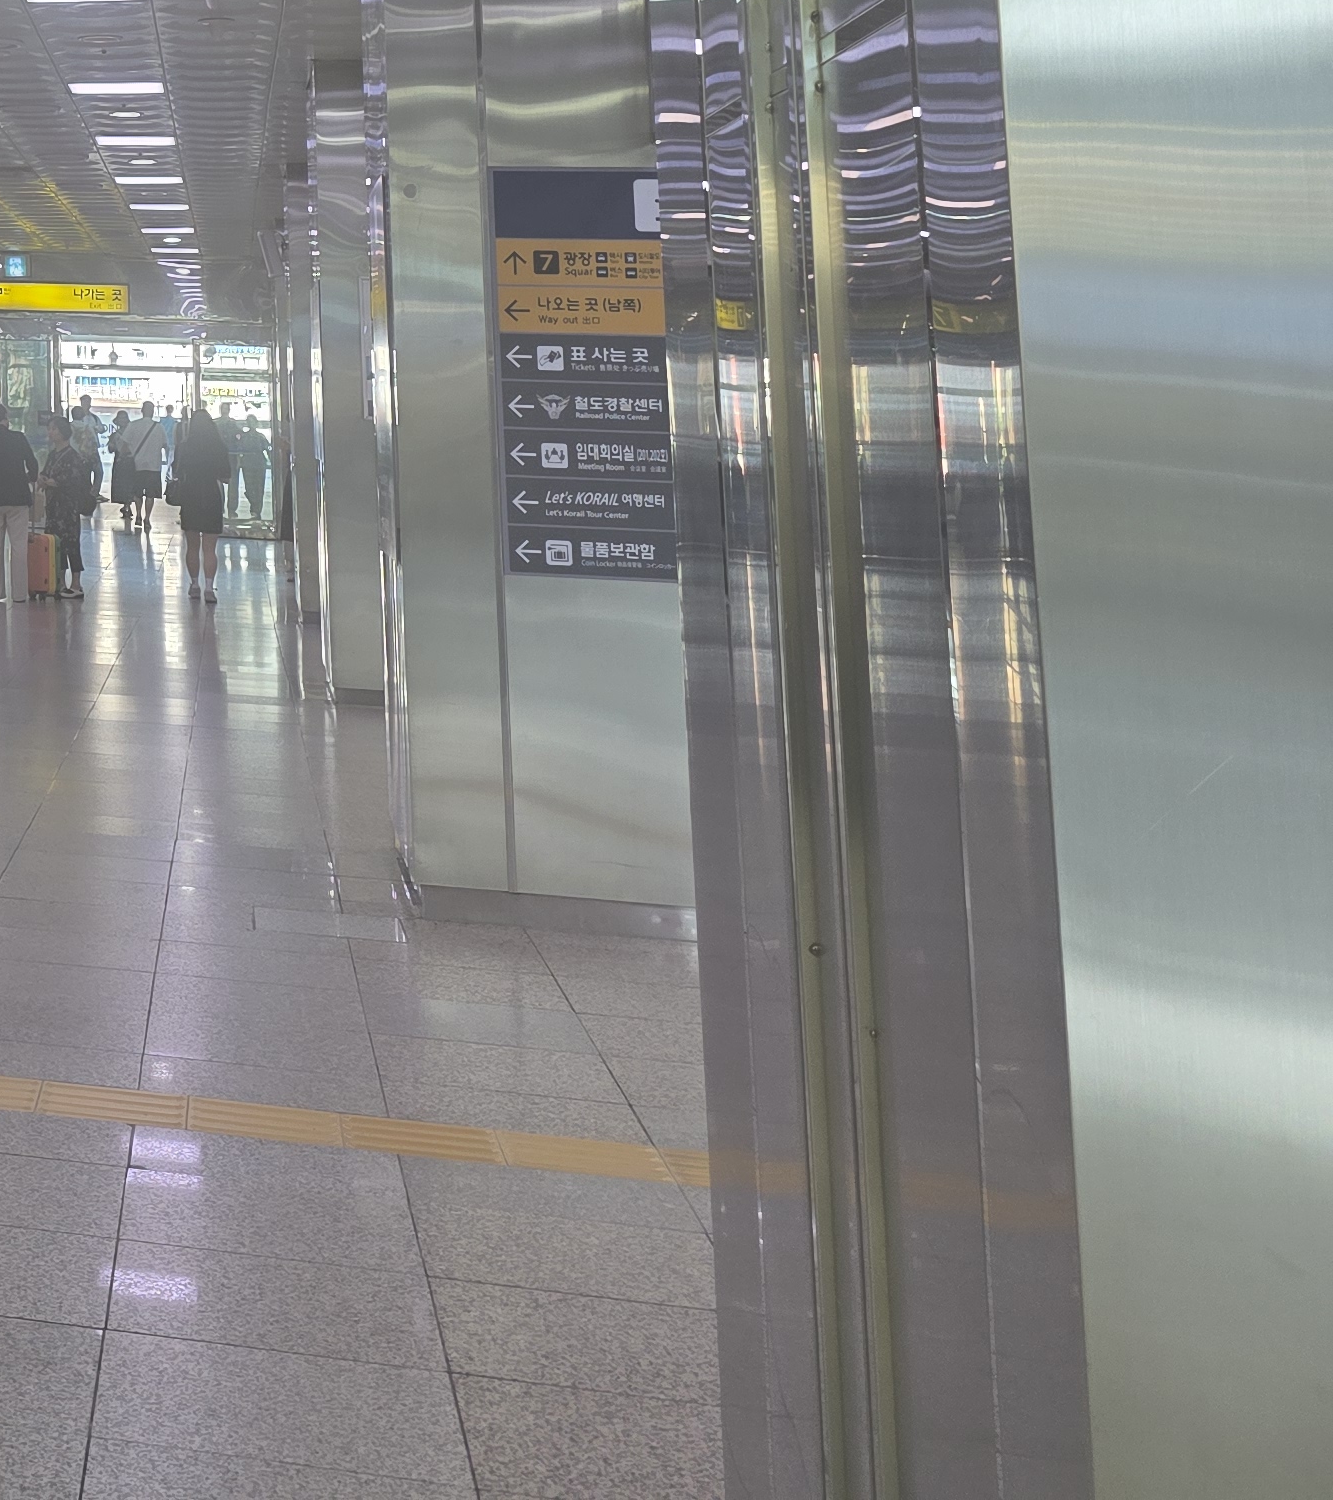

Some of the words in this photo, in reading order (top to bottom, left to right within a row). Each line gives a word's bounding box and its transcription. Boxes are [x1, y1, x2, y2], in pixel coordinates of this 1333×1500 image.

[539, 254, 554, 271] 7
[563, 252, 593, 267] 광장
[73, 288, 106, 301] 나가는
[111, 289, 122, 301] 곳
[537, 296, 580, 312] 나오는
[585, 297, 599, 312] 곳
[602, 297, 642, 313] (남쪽)
[538, 315, 559, 326] Way
[562, 316, 579, 325] out
[582, 316, 600, 325] 出口
[570, 346, 587, 361] 표
[591, 347, 627, 362] 사는
[631, 348, 649, 363] 곳
[570, 363, 596, 371] Tickets
[574, 395, 663, 413] 철도경찰센터
[575, 412, 604, 420] Railroad
[604, 412, 626, 421] Police
[626, 413, 651, 421] Center
[575, 442, 635, 462] 임대회의실
[577, 462, 605, 473] Meeting
[606, 463, 625, 471] Room
[544, 490, 574, 505] Let's
[574, 491, 620, 506] KORAIL
[621, 493, 665, 509] 여행센터
[545, 509, 563, 517] Let's
[563, 509, 585, 518] Korail
[585, 510, 603, 518] Tour
[603, 511, 629, 519] Center
[580, 541, 656, 560] 물품보관함
[581, 559, 595, 567] Coin
